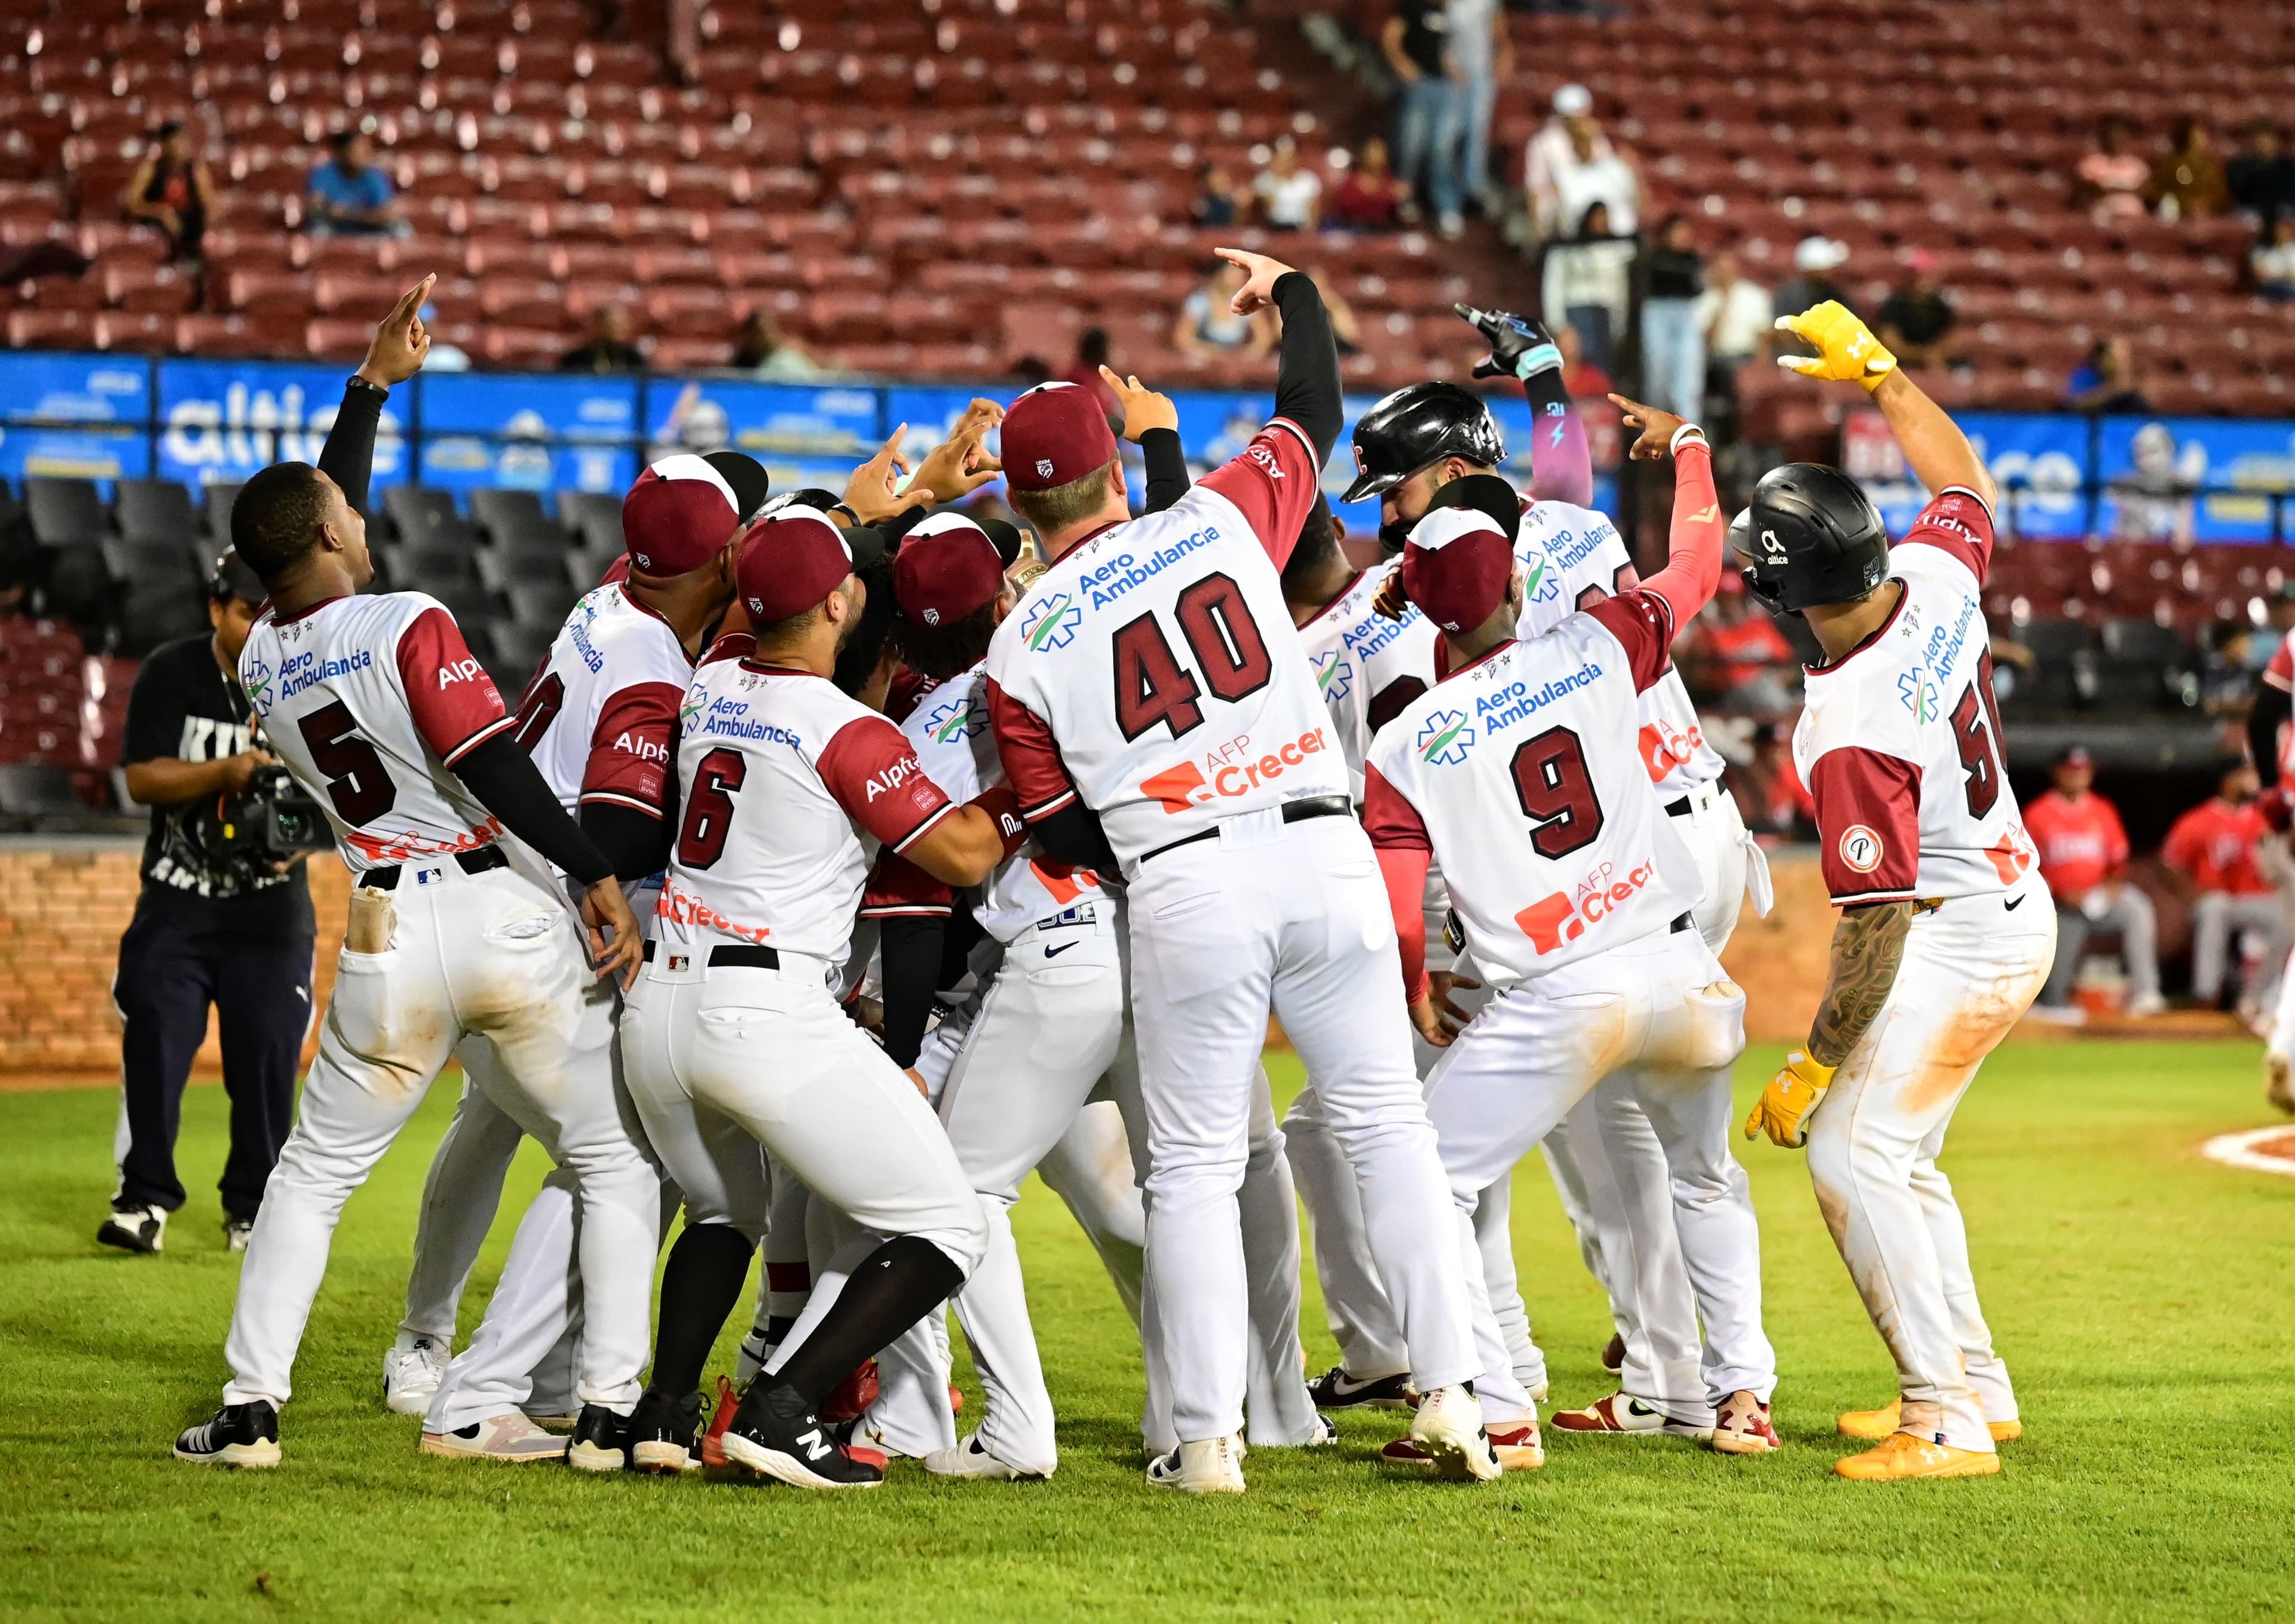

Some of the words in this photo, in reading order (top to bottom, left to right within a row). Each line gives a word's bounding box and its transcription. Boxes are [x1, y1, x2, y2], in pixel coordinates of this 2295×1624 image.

[1542, 530, 1572, 557] Aero
[1767, 555, 1788, 565] altice
[1079, 552, 1134, 594] Aero
[1091, 524, 1220, 611] Ambulancia
[279, 651, 313, 679] Aero
[1112, 571, 1272, 744] 40
[1922, 626, 1946, 670] Aero
[282, 650, 371, 700] Ambulancia
[439, 654, 483, 691] Alp
[709, 696, 749, 715] Aero
[1476, 682, 1526, 717] Aero
[1486, 663, 1602, 736] Ambulancia
[613, 731, 670, 765] Alph
[702, 715, 801, 750] Ambulancia
[1207, 735, 1250, 772] AFP
[298, 699, 397, 828] 5
[1215, 727, 1327, 796] Crecer
[678, 747, 746, 871] 6
[1509, 724, 1604, 860] 9
[1577, 862, 1612, 900] AFP
[1581, 857, 1655, 924] Crec
